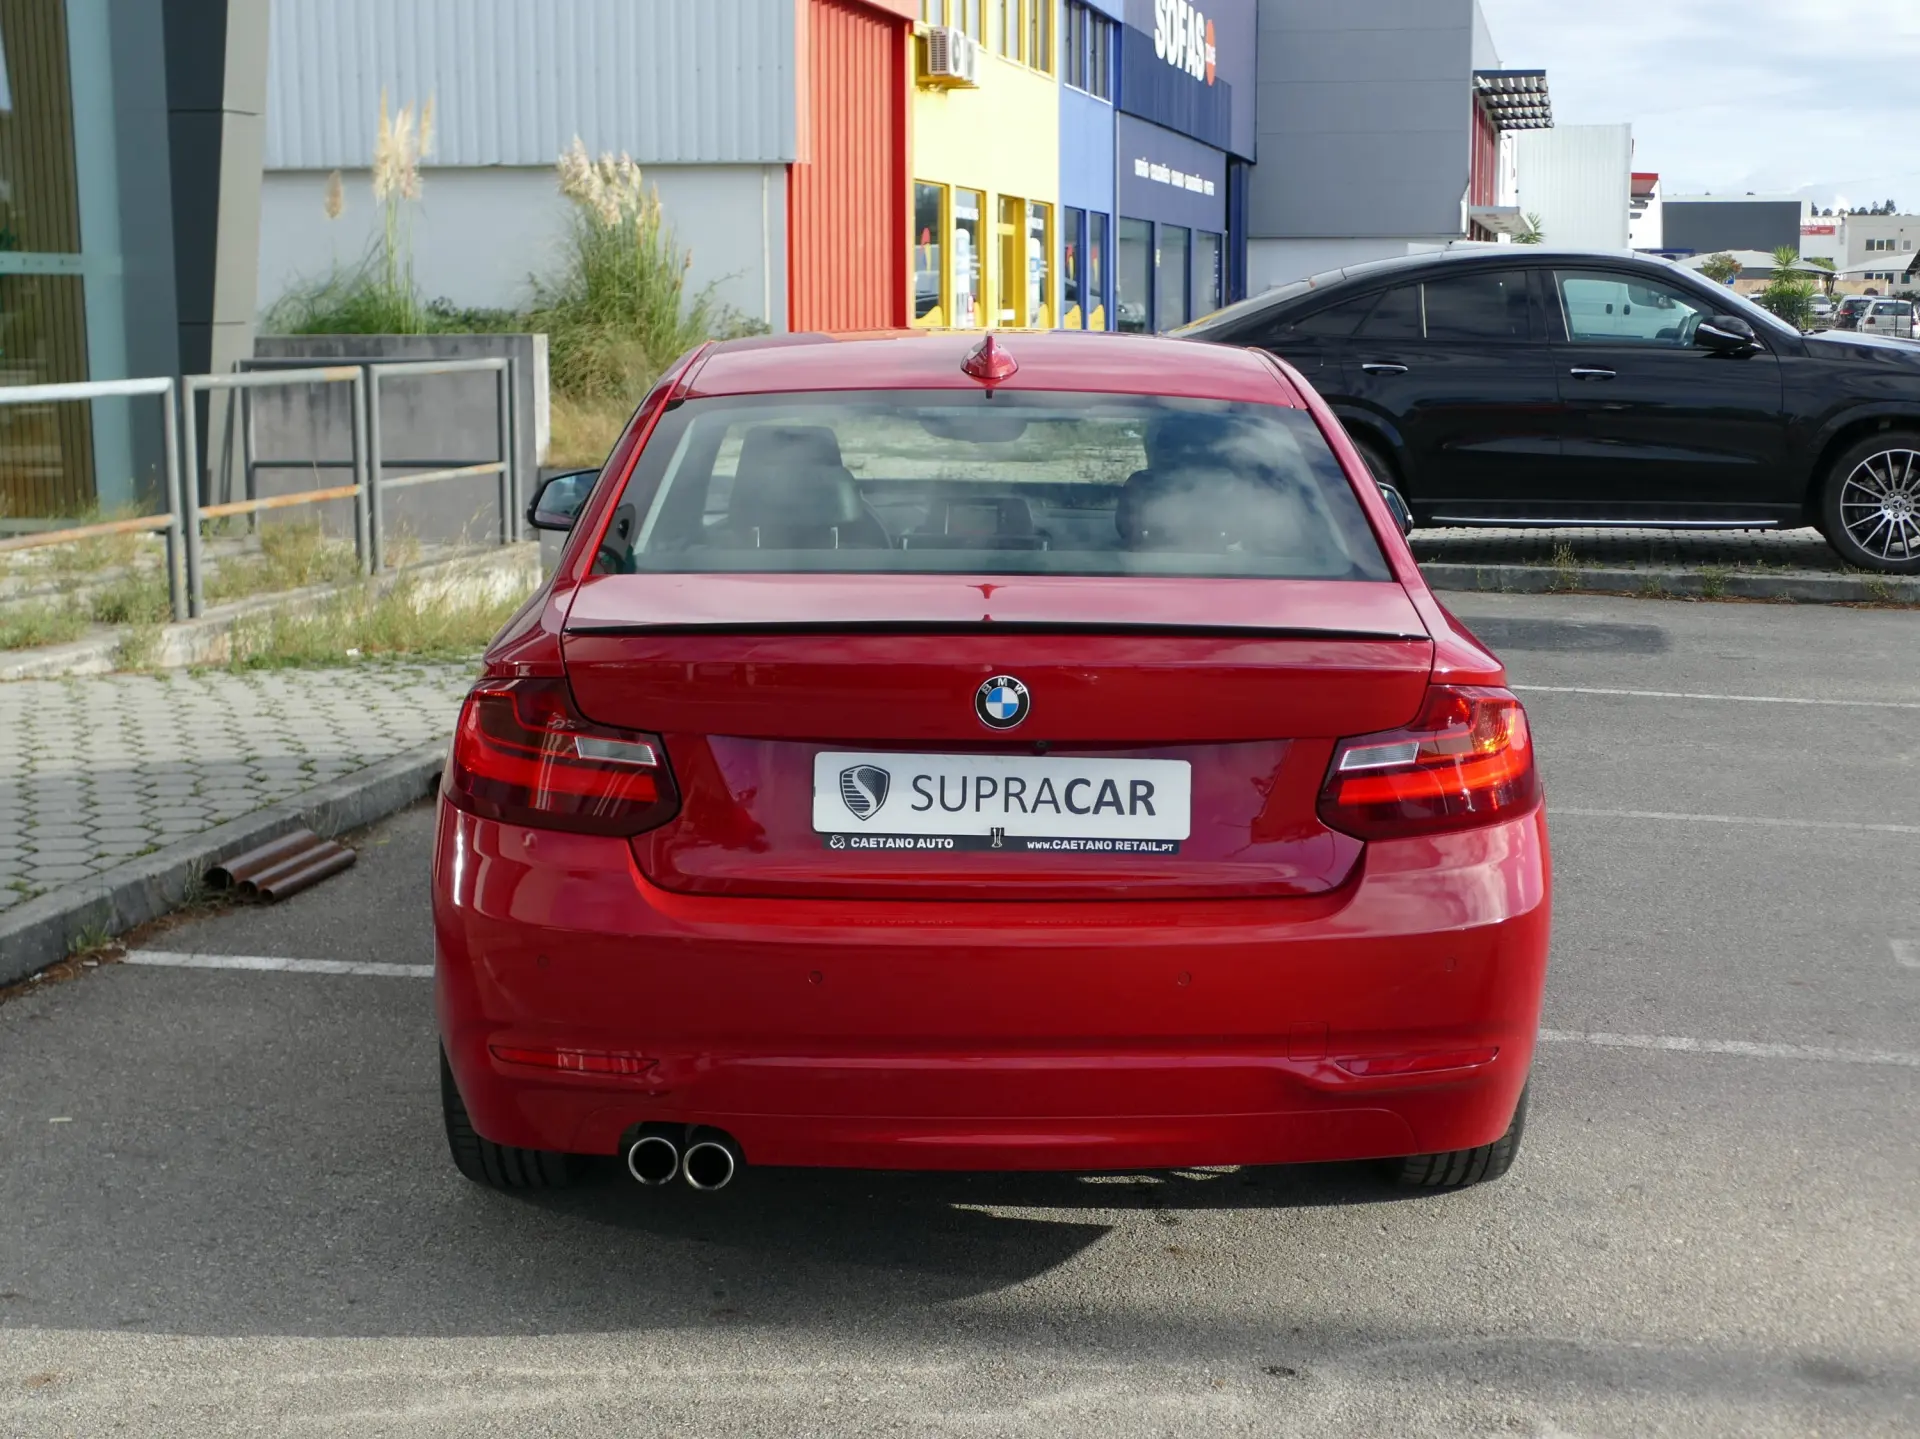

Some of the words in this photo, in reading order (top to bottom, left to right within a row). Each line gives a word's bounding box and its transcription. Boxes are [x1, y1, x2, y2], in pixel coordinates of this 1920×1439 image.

[980, 677, 1025, 696] BMW
[911, 774, 1157, 817] SUPRACAR
[850, 837, 914, 849] CAETANO
[916, 838, 954, 849] AUTO
